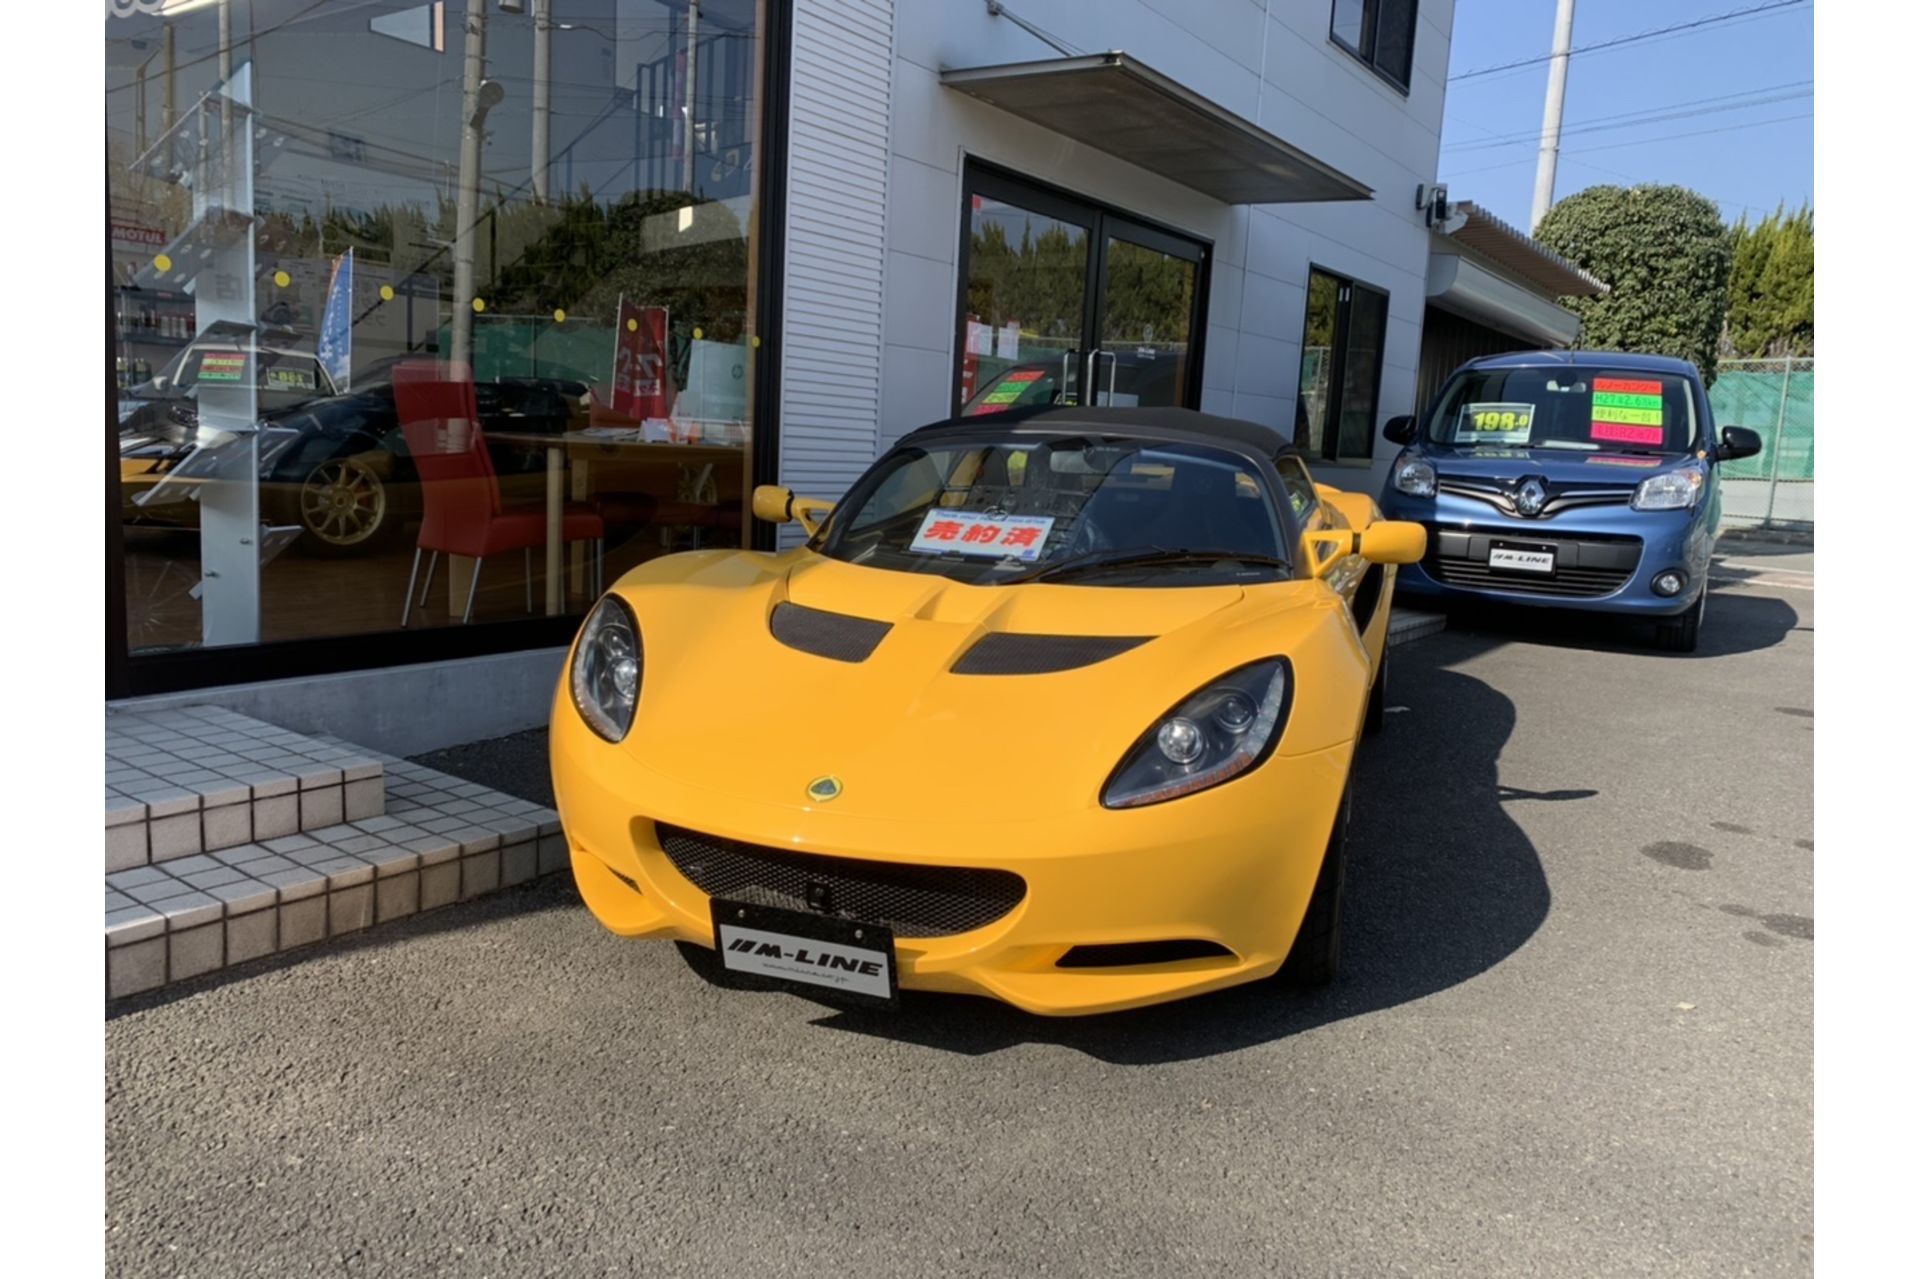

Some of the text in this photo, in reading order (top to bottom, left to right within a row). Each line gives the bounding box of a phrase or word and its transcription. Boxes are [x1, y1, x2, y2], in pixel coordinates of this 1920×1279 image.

[112, 227, 162, 243] MOTUL
[923, 520, 1043, 548] 売約済
